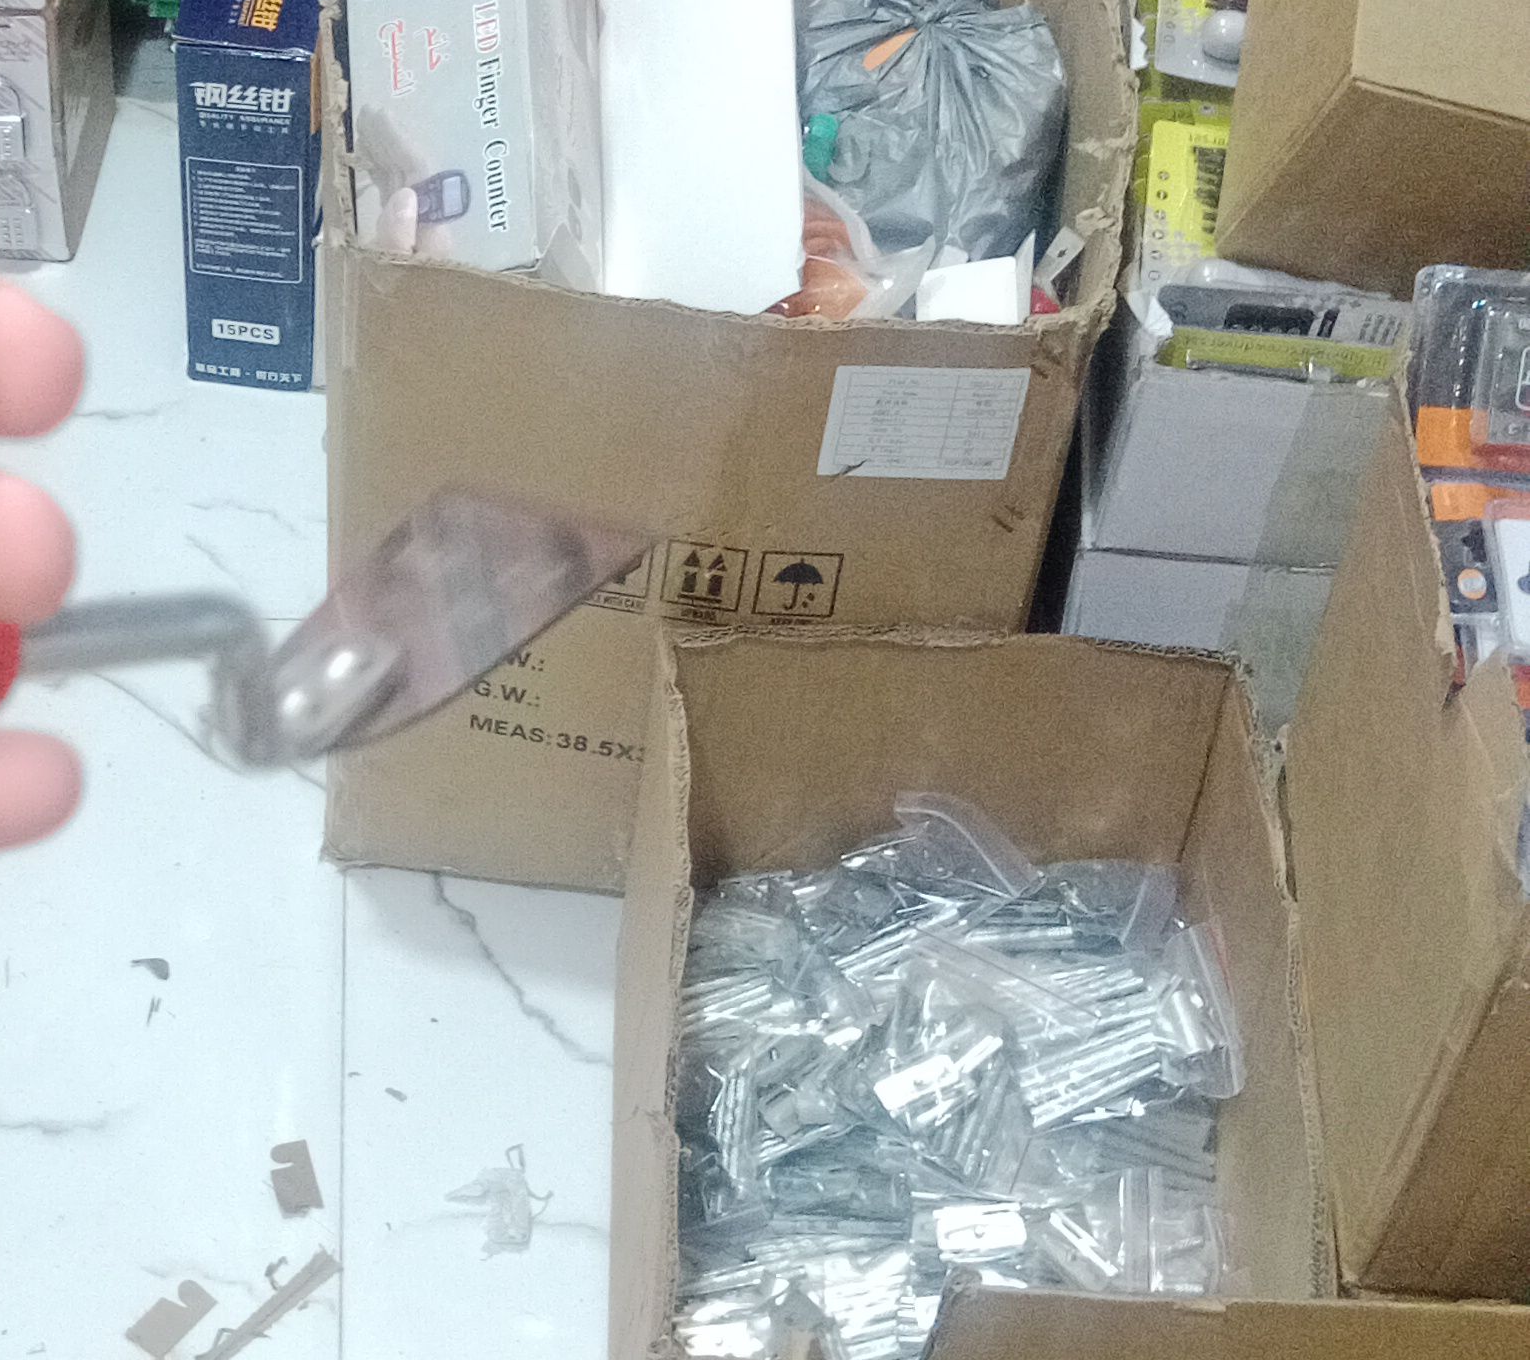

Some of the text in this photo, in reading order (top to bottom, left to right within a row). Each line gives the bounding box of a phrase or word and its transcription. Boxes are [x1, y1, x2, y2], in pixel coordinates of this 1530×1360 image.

[190, 82, 296, 113] 钢丝钳
[473, 1, 509, 233] LED Finger Counter
[217, 323, 275, 340] 15PCS
[472, 680, 541, 707] G.W.:
